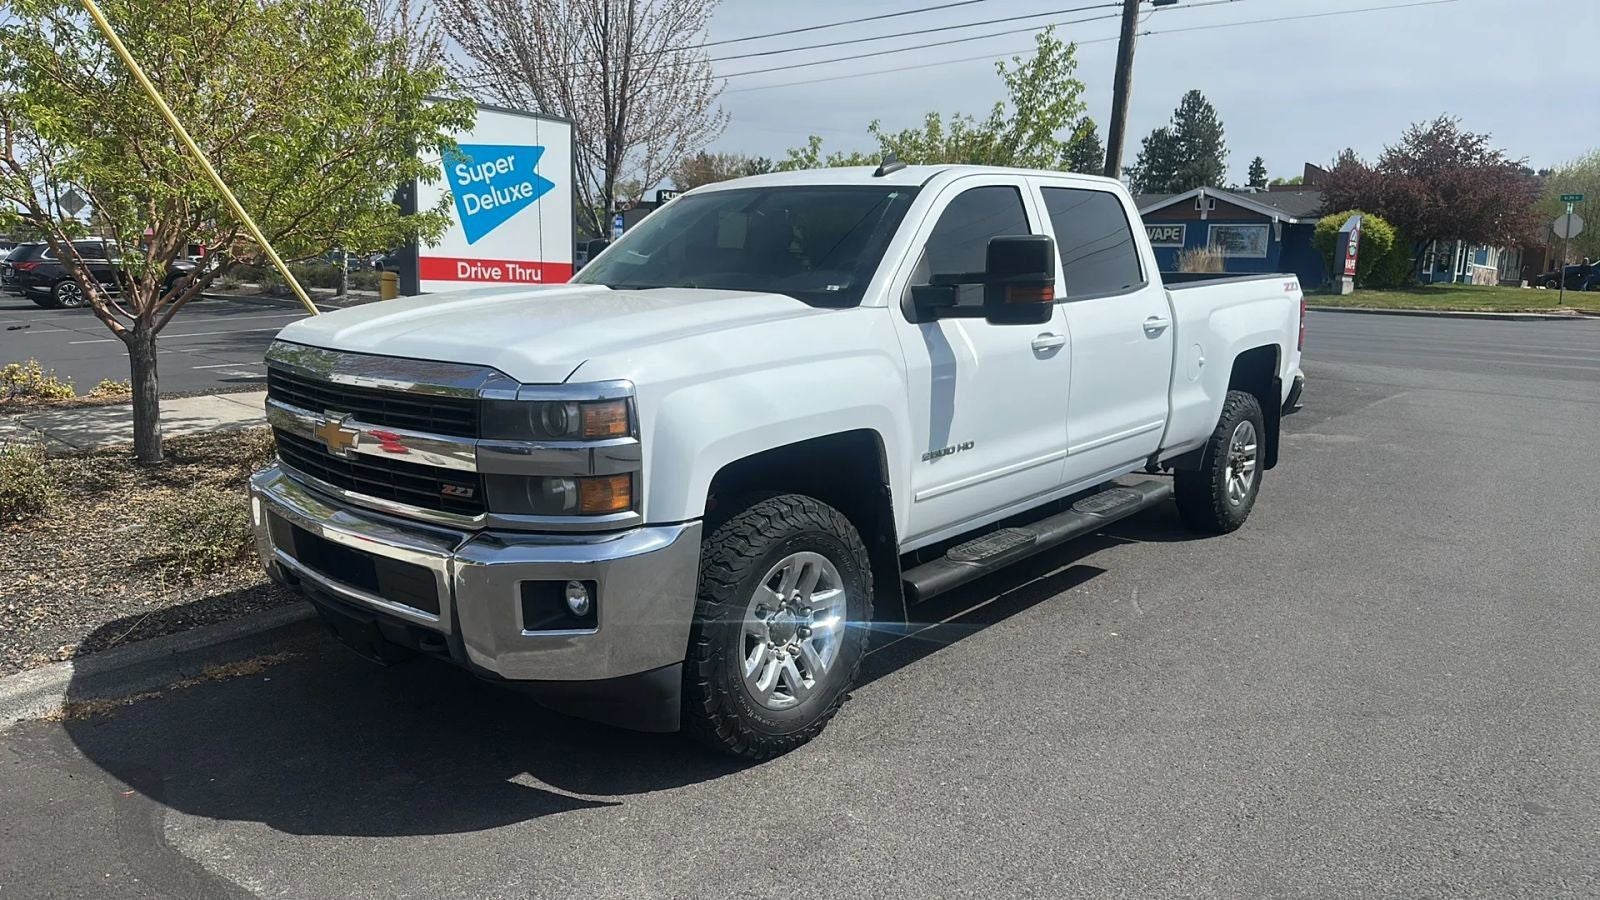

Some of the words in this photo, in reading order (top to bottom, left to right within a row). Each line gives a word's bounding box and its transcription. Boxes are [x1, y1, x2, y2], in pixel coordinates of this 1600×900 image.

[455, 153, 517, 187] Super
[462, 179, 533, 216] Deluxe
[1147, 227, 1180, 240] VAPE
[457, 261, 502, 280] Drive
[504, 263, 542, 281] Thru
